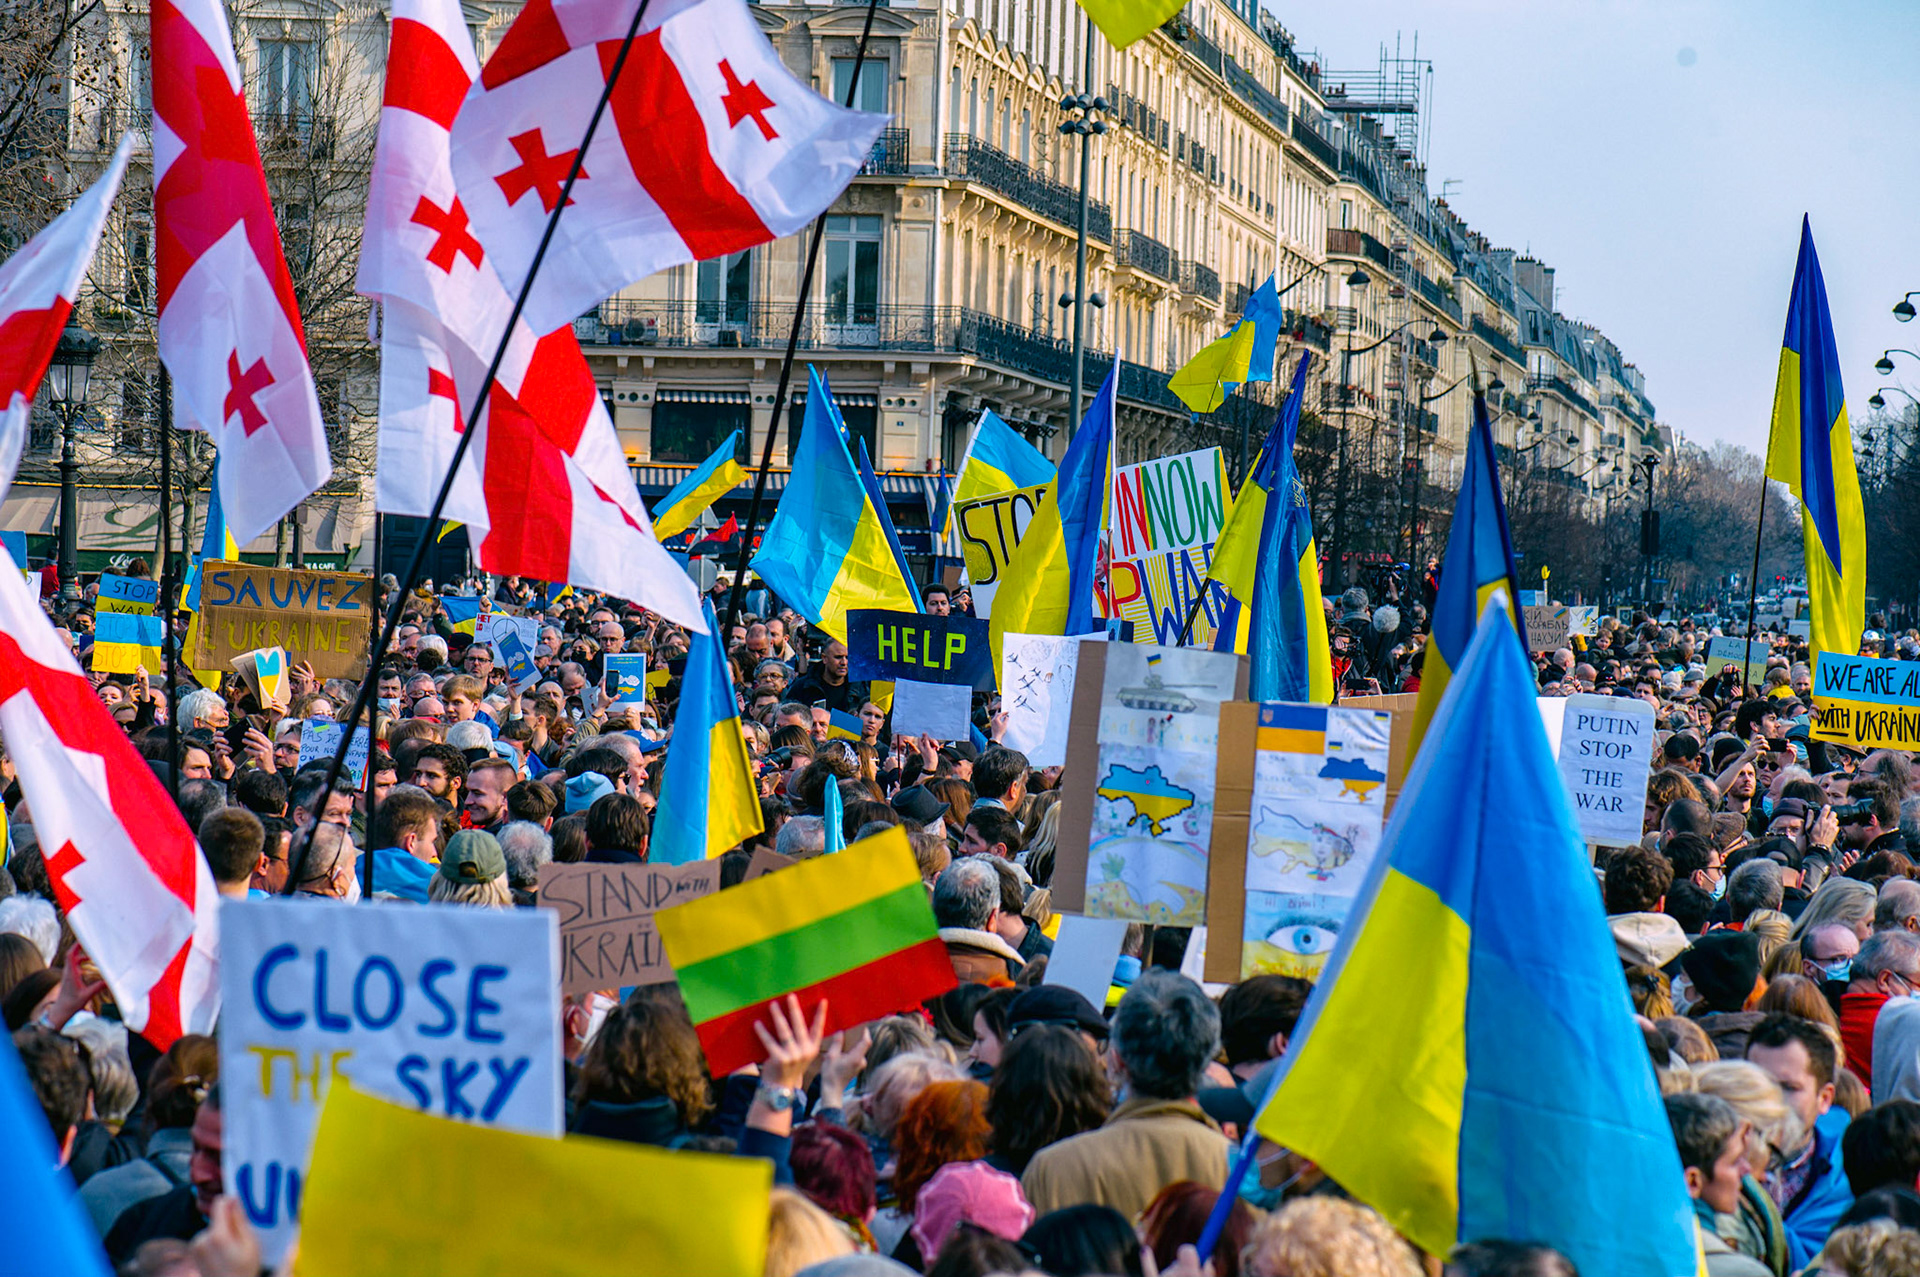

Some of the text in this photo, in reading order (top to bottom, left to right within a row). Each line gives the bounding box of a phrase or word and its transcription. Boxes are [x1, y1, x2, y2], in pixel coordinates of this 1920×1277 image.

[960, 488, 1048, 585] STO
[113, 580, 155, 599] STOP
[211, 571, 366, 611] SAUVEZ
[204, 620, 352, 653] L'UKRAINE
[877, 624, 967, 670] HELP
[1729, 640, 1741, 649] LA
[1823, 662, 1920, 699] WE ARE AL
[1577, 714, 1640, 735] PUTIN
[323, 746, 337, 754] NO
[1580, 739, 1632, 759] STOP
[1582, 768, 1623, 788] THE
[1576, 792, 1624, 813] WAR
[542, 869, 672, 927] STAND
[560, 921, 662, 984] KRAÏ
[252, 943, 509, 1044] CLOSE
[396, 1054, 531, 1122] SKY
